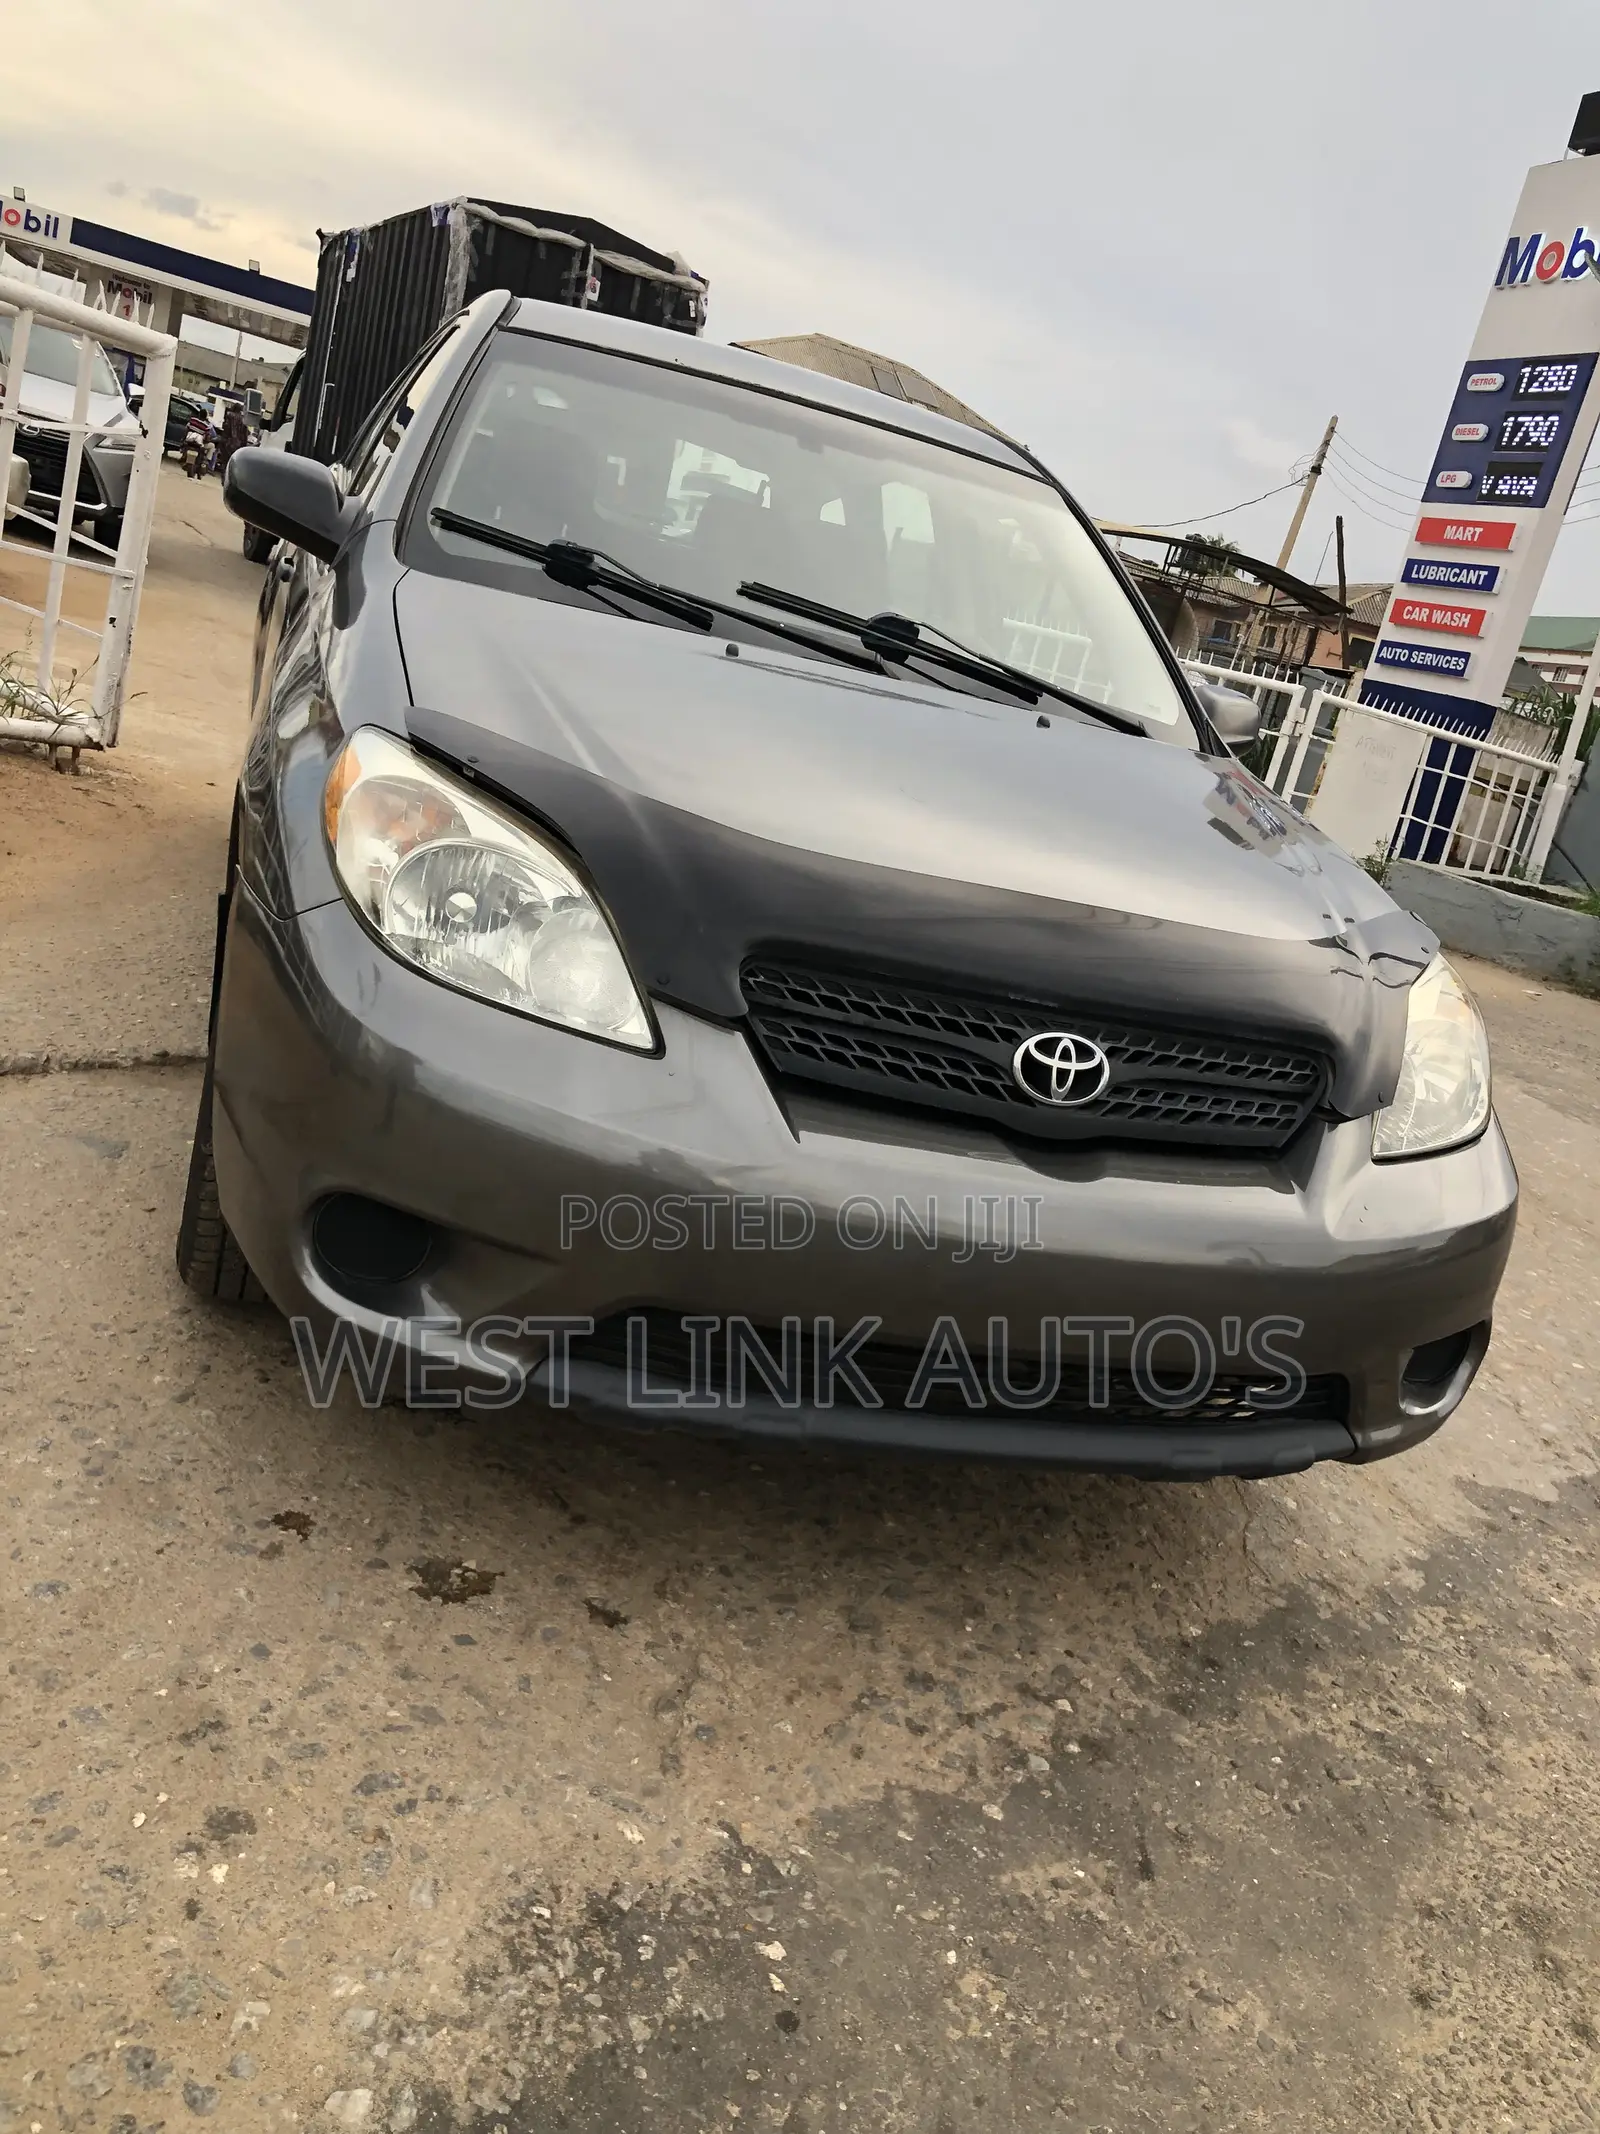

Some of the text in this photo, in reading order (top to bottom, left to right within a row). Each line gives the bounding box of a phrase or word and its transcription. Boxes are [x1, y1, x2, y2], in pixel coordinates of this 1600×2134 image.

[0, 200, 59, 239] obil
[1494, 226, 1600, 287] Mob
[1470, 377, 1497, 386] PETROL
[1455, 427, 1480, 436] DIESEL
[1440, 474, 1457, 484] LPG
[1443, 525, 1483, 542] MART
[1411, 564, 1488, 585] LUBRICANT
[1403, 605, 1471, 628] CAR WASH
[1379, 646, 1466, 671] AUTO SERVICES
